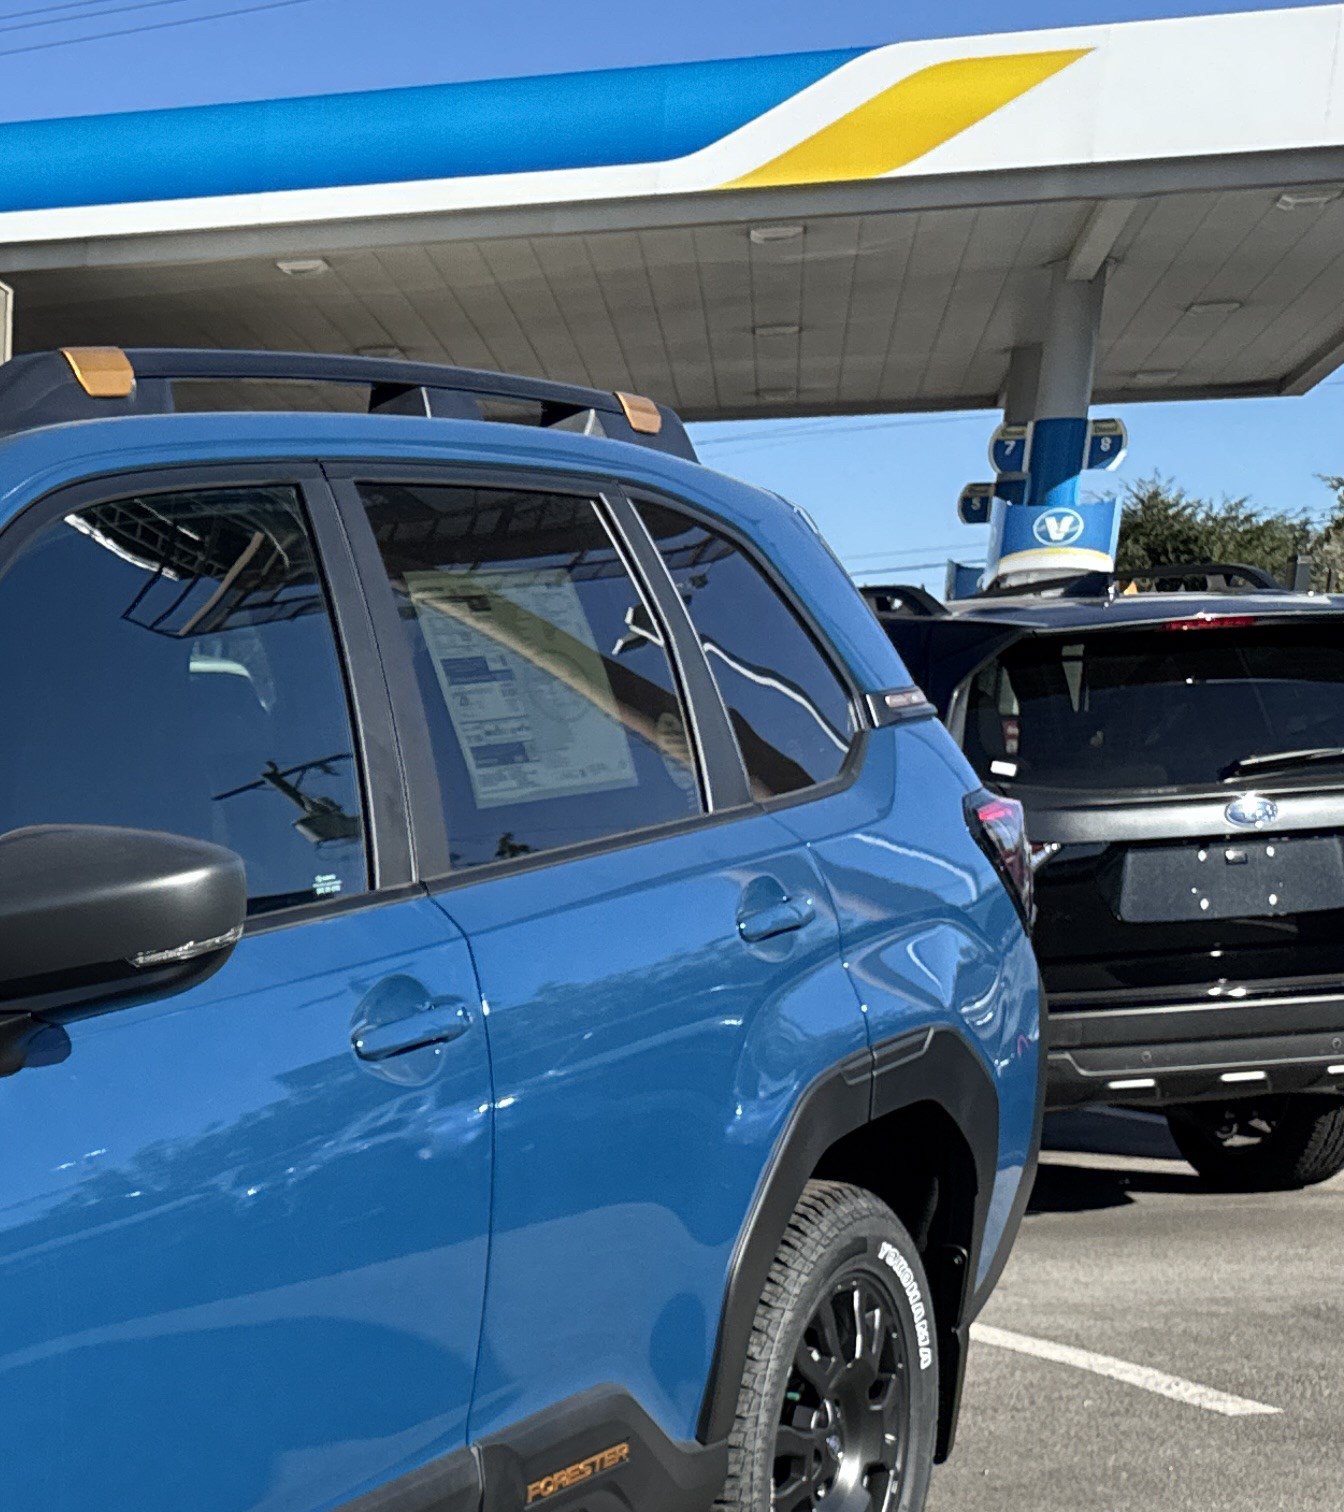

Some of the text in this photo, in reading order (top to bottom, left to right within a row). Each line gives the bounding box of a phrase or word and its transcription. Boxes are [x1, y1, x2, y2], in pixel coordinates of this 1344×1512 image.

[1004, 441, 1015, 456] 7
[1100, 436, 1111, 452] 8
[526, 1442, 629, 1504] FORESTER
